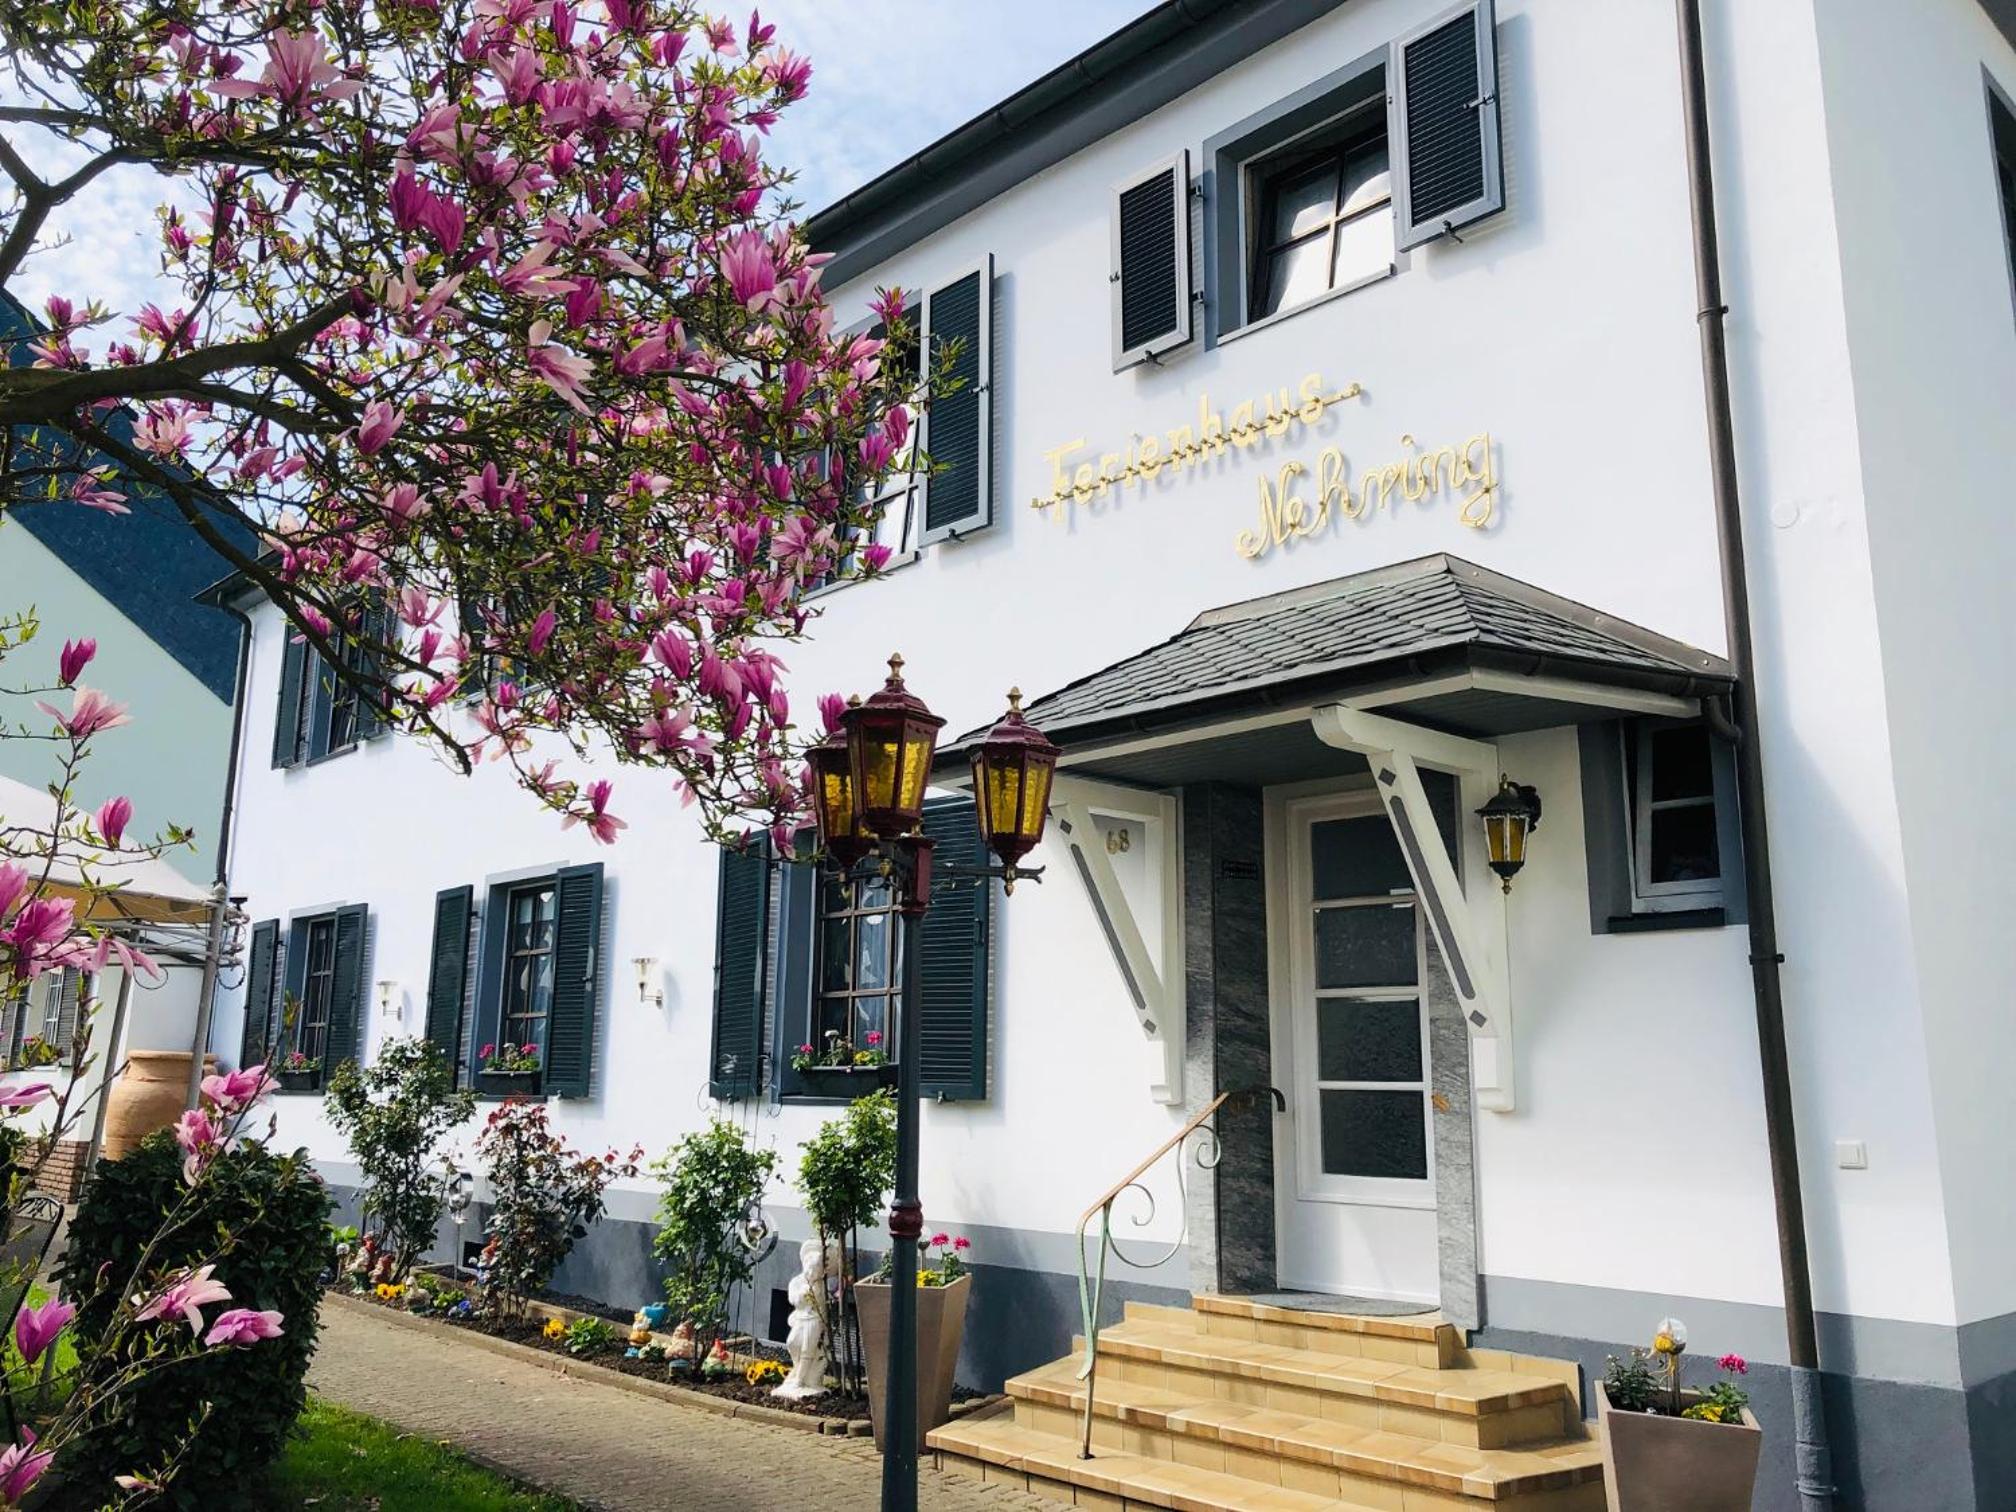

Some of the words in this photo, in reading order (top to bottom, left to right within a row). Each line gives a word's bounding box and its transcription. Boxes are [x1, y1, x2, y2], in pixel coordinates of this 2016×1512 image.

[1043, 373, 1325, 525] Ferienhaus
[1235, 431, 1498, 559] Nehring
[1106, 828, 1130, 855] 68
